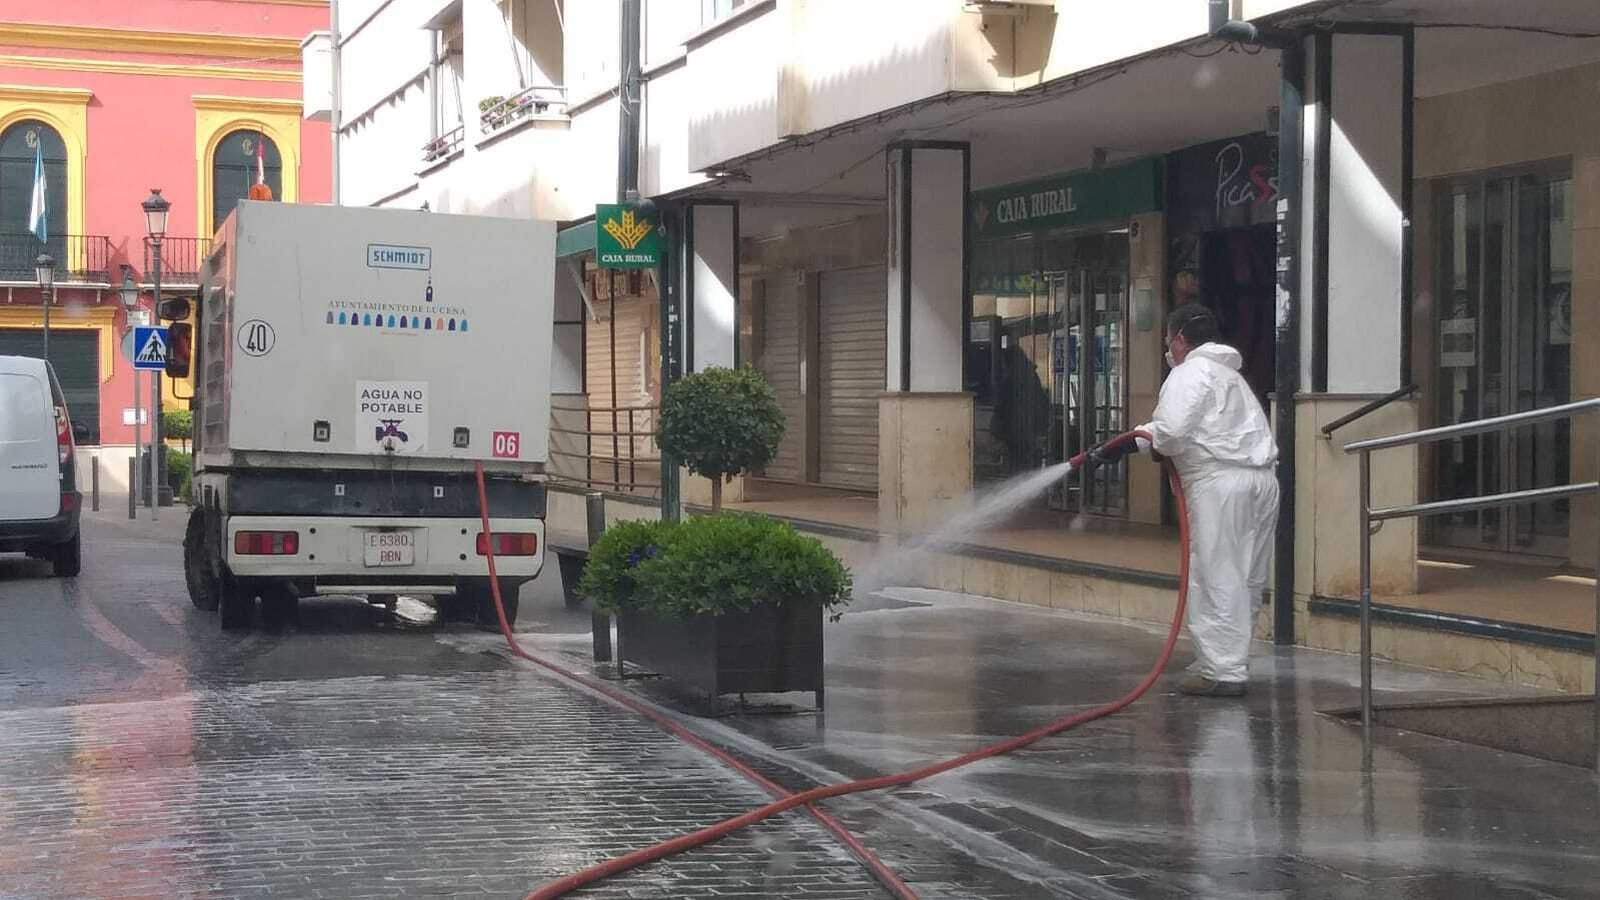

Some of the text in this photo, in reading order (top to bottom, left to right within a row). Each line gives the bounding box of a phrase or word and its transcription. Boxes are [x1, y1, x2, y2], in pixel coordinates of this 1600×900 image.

[996, 187, 1077, 223] CAJA RURAL
[373, 250, 426, 265] SCHMIDT
[602, 254, 655, 263] CAJA RURAL
[328, 300, 466, 316] AYUNTAMIENTO DE LUCENA
[246, 324, 266, 352] 40
[361, 389, 423, 400] AGUA NO
[361, 403, 423, 413] POTABLE
[495, 434, 516, 455] 06
